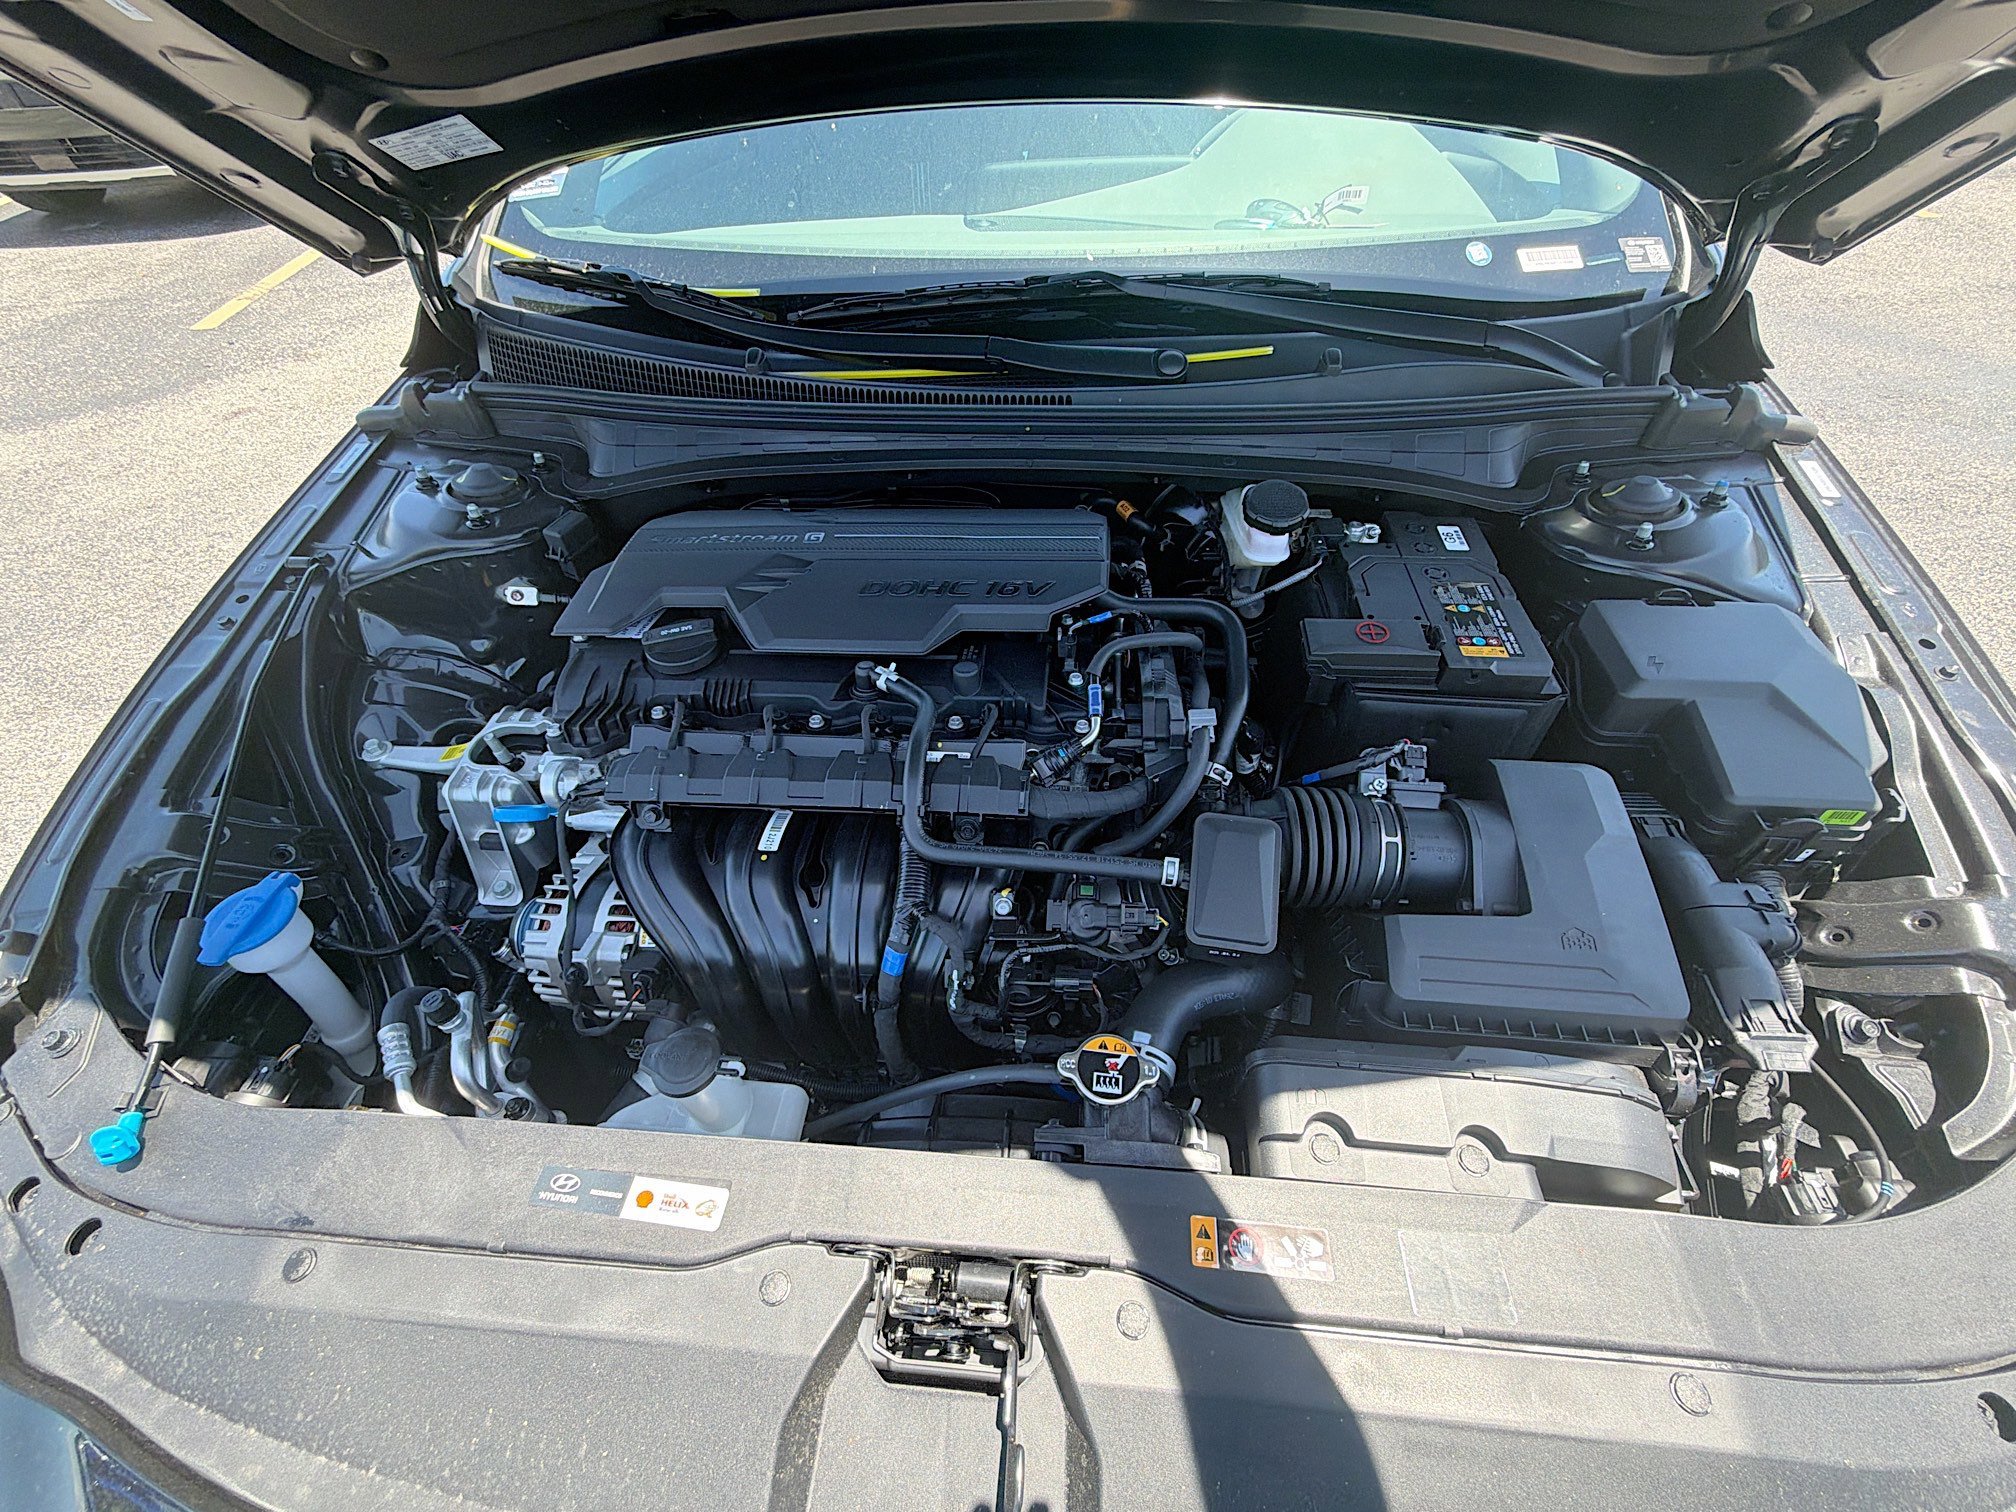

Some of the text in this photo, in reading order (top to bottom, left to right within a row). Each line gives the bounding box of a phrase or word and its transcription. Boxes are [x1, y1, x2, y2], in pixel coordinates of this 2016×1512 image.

[1442, 532, 1456, 544] G6
[858, 580, 1057, 597] DOHC 16V
[1144, 1065, 1156, 1077] 1.1
[538, 1191, 579, 1204] HYUNDAI
[661, 1198, 690, 1210] HELIX
